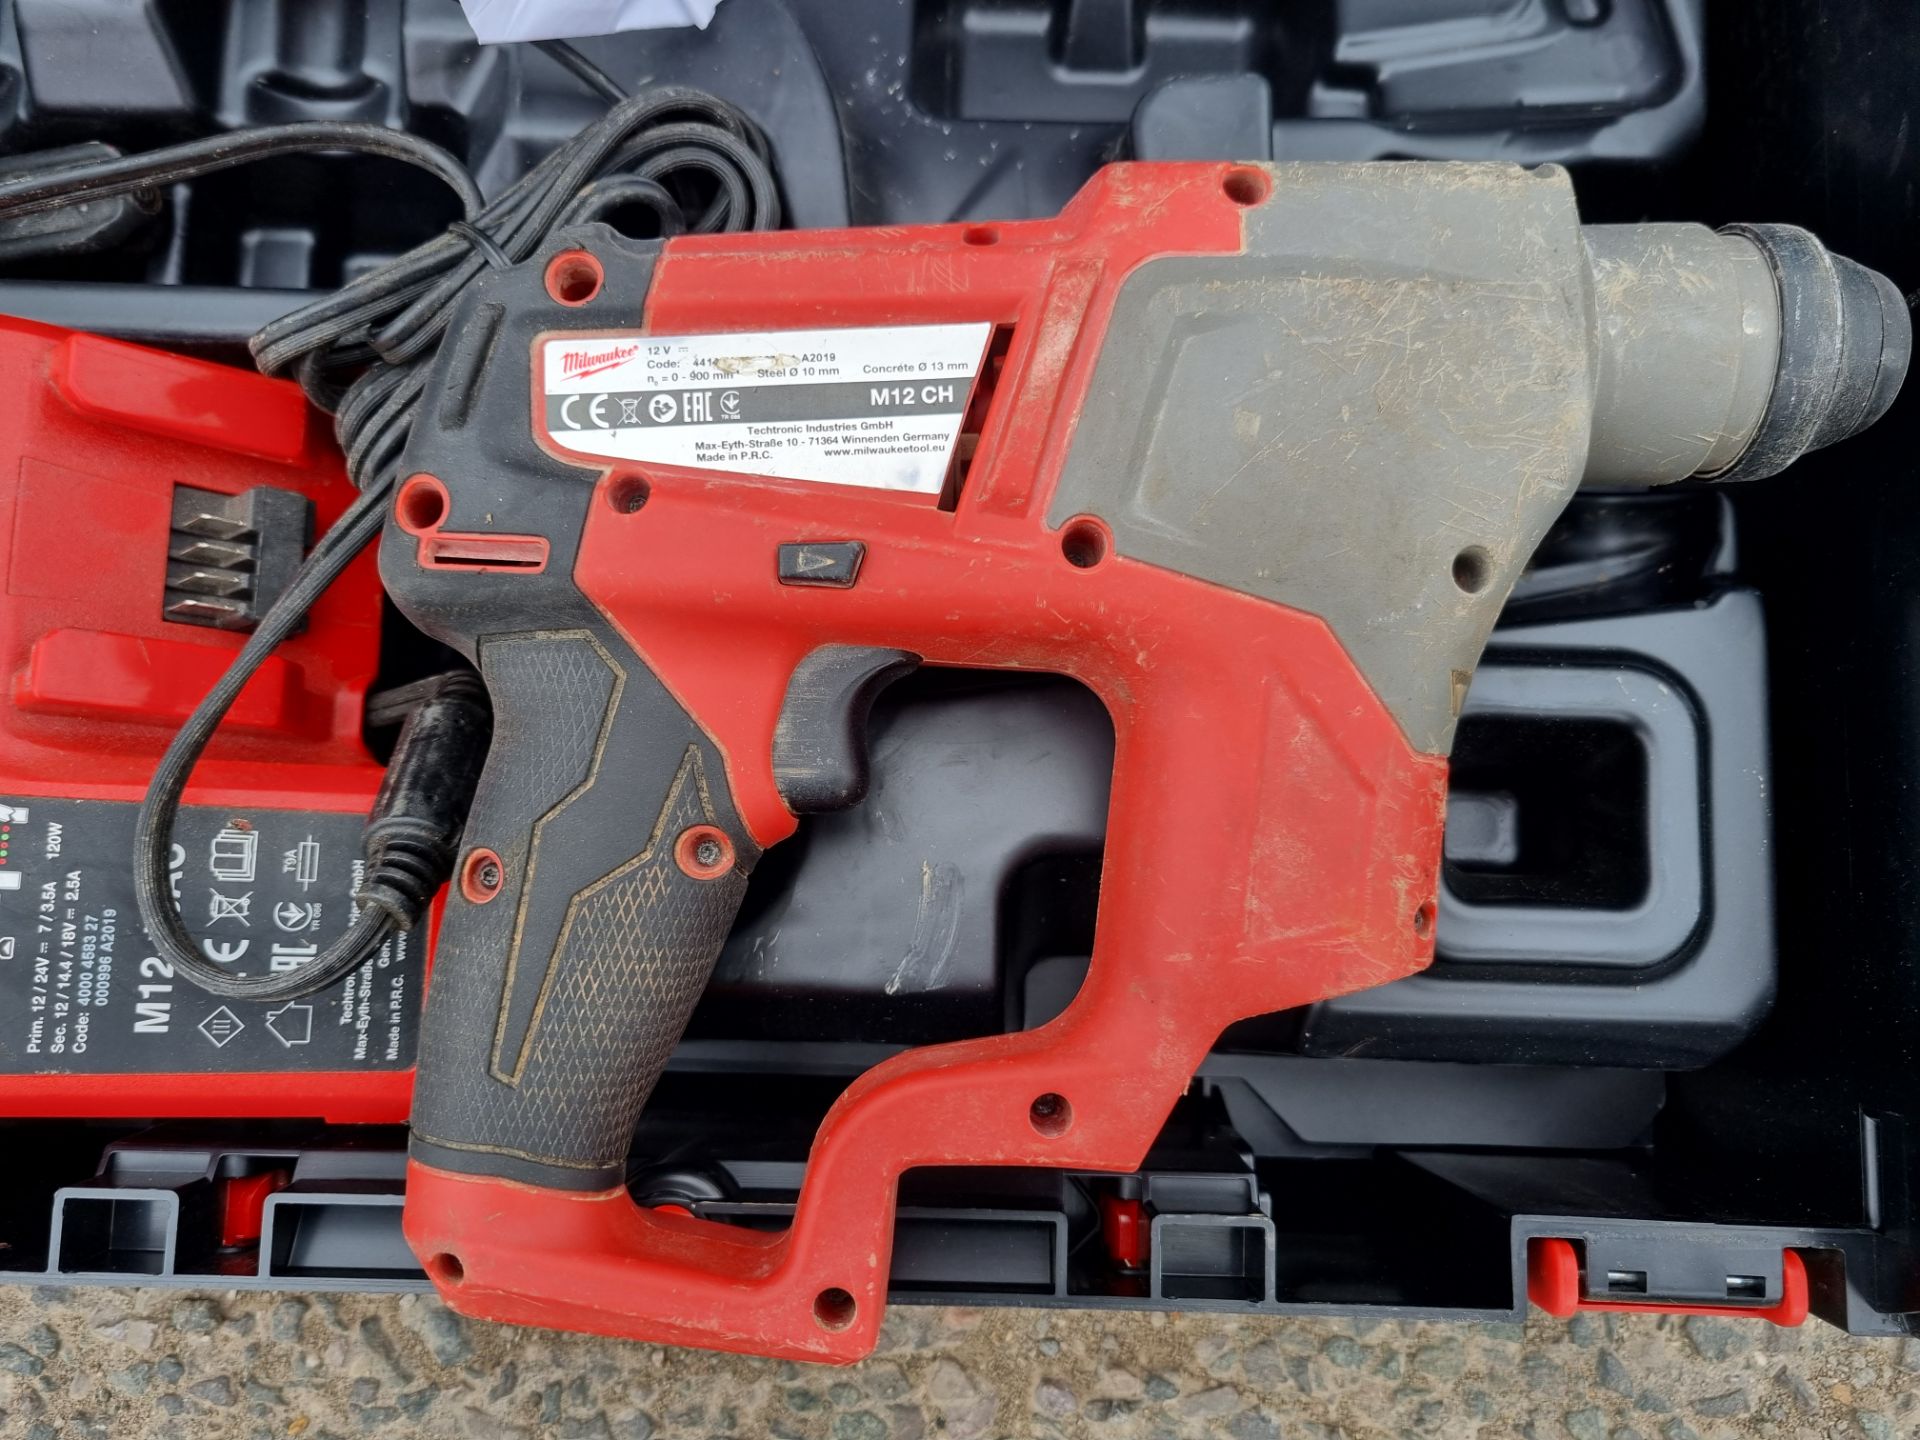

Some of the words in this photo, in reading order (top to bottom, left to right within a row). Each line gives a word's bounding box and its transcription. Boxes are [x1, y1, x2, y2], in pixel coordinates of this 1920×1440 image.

[560, 346, 634, 374] Milwaukee
[647, 346, 660, 356] 12
[661, 345, 671, 355] V
[647, 359, 681, 369] Code:
[801, 352, 836, 363] A2019
[671, 372, 679, 382] 0
[690, 370, 710, 382] 900
[757, 368, 786, 379] Steel
[803, 366, 815, 377] 10
[818, 367, 840, 376] mm
[931, 361, 944, 371] 13
[947, 361, 969, 370] mm
[870, 387, 915, 406] M12
[921, 385, 954, 404] CH
[747, 423, 803, 435] Techtronic
[806, 421, 858, 433] Industries
[861, 420, 893, 430] GmbH
[695, 436, 783, 452] Max-Eyth-Straße
[787, 435, 798, 446] 10
[809, 435, 839, 446] 71364
[841, 432, 900, 444] Winnenden
[902, 431, 950, 444] Germany
[697, 452, 725, 462] Made
[728, 451, 738, 461] in
[741, 450, 773, 460] P.R.C.
[824, 444, 946, 457] www.milwaukeetool.eu
[46, 821, 63, 860] 120W
[283, 849, 298, 873] T9A
[41, 881, 57, 912] 3.5A
[65, 870, 82, 901] 2.5A
[38, 925, 53, 934] 7
[60, 922, 77, 947] 18V
[84, 914, 99, 931] 27
[100, 908, 117, 952] A2019
[81, 935, 97, 968] 4583
[35, 957, 50, 984] 24V
[57, 960, 72, 989] 14.4
[94, 955, 113, 1007] 000996
[78, 972, 93, 1007] 4000
[390, 973, 405, 1009] P.R.C.
[31, 996, 47, 1013] 12
[54, 1001, 69, 1019] 12
[388, 1012, 401, 1024] in
[26, 1016, 45, 1054] Prim.
[50, 1022, 67, 1054] Sec.
[72, 1012, 90, 1054] Code:
[386, 1027, 402, 1060] Made
